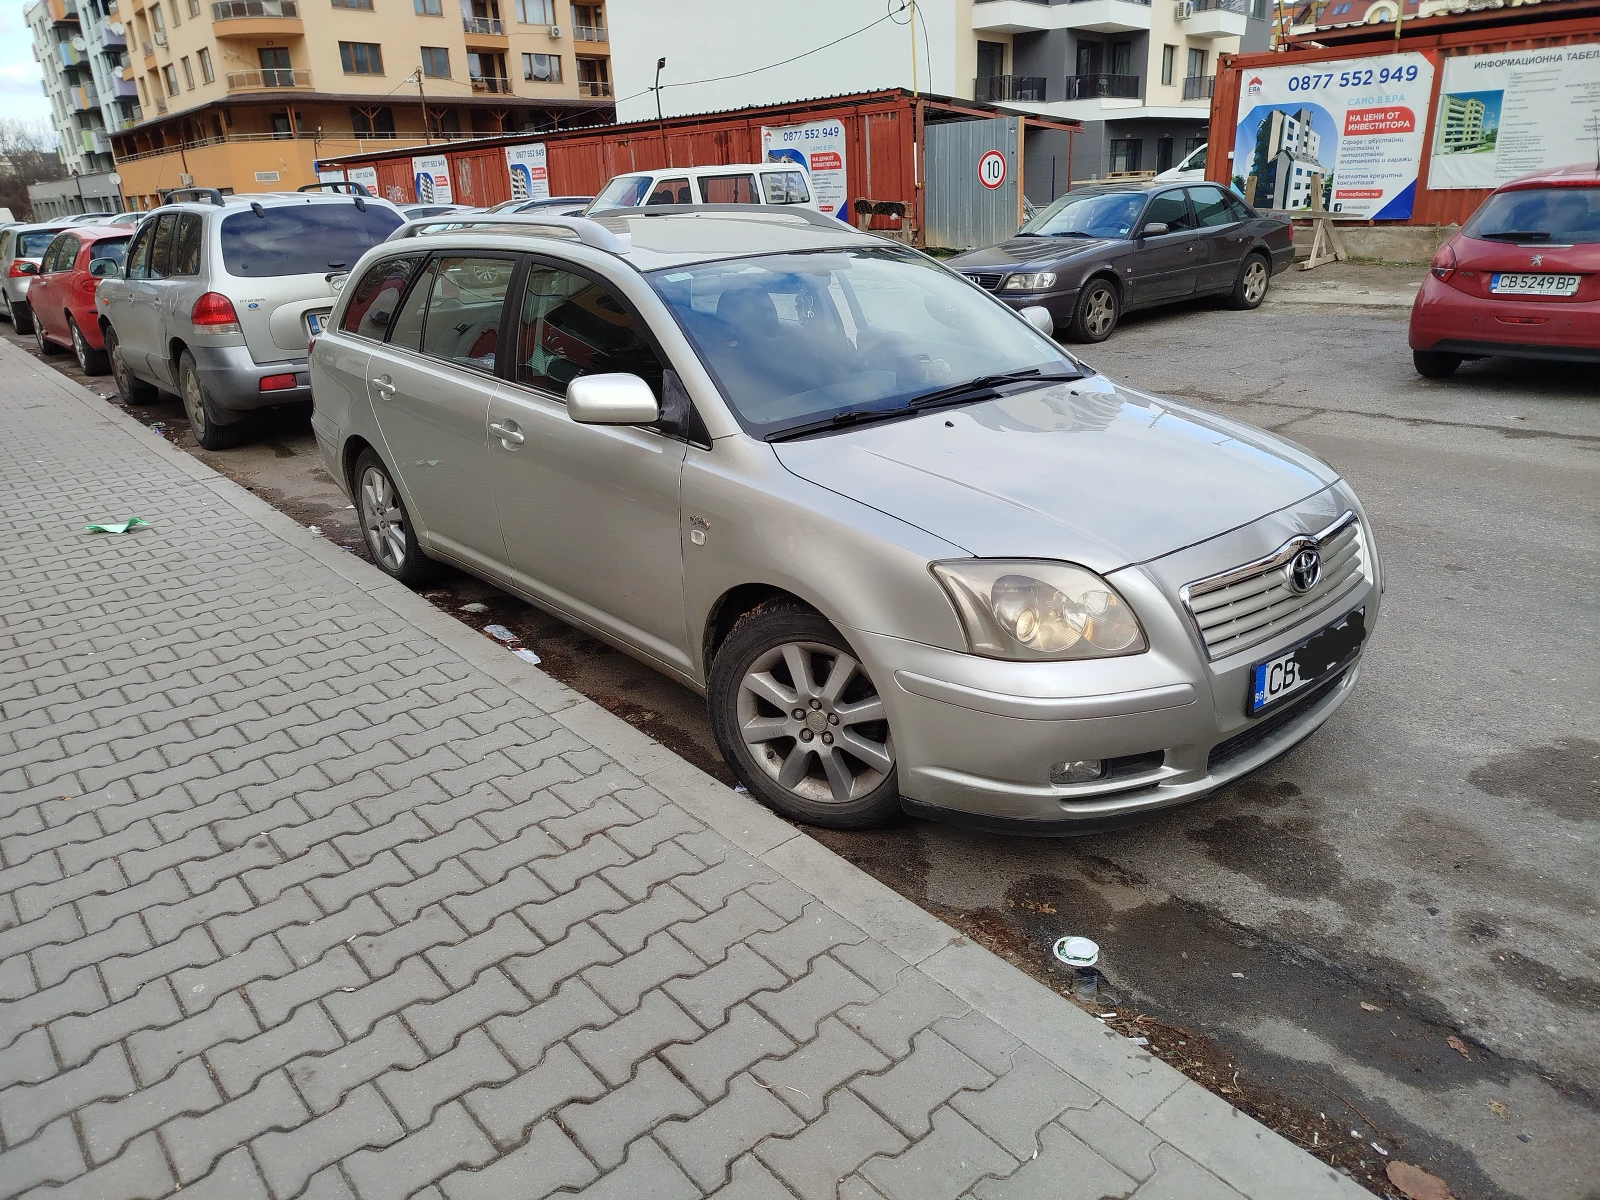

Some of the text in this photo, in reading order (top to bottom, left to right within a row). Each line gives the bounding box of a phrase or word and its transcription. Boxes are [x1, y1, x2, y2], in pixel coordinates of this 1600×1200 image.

[1474, 50, 1600, 69] ИНФОРМАЦИОННА ТАБЕЛ
[1288, 65, 1418, 92] 0877 552 949
[1347, 94, 1406, 106] САМО В ЕРА
[1349, 111, 1401, 122] НА ЦЕНИ ОТ
[1348, 120, 1411, 131] ИНВЕСТИТОРА
[783, 131, 802, 142] 0877
[804, 129, 820, 139] 552
[822, 127, 839, 138] 949
[987, 160, 1000, 179] 10
[1254, 690, 1264, 703] BG
